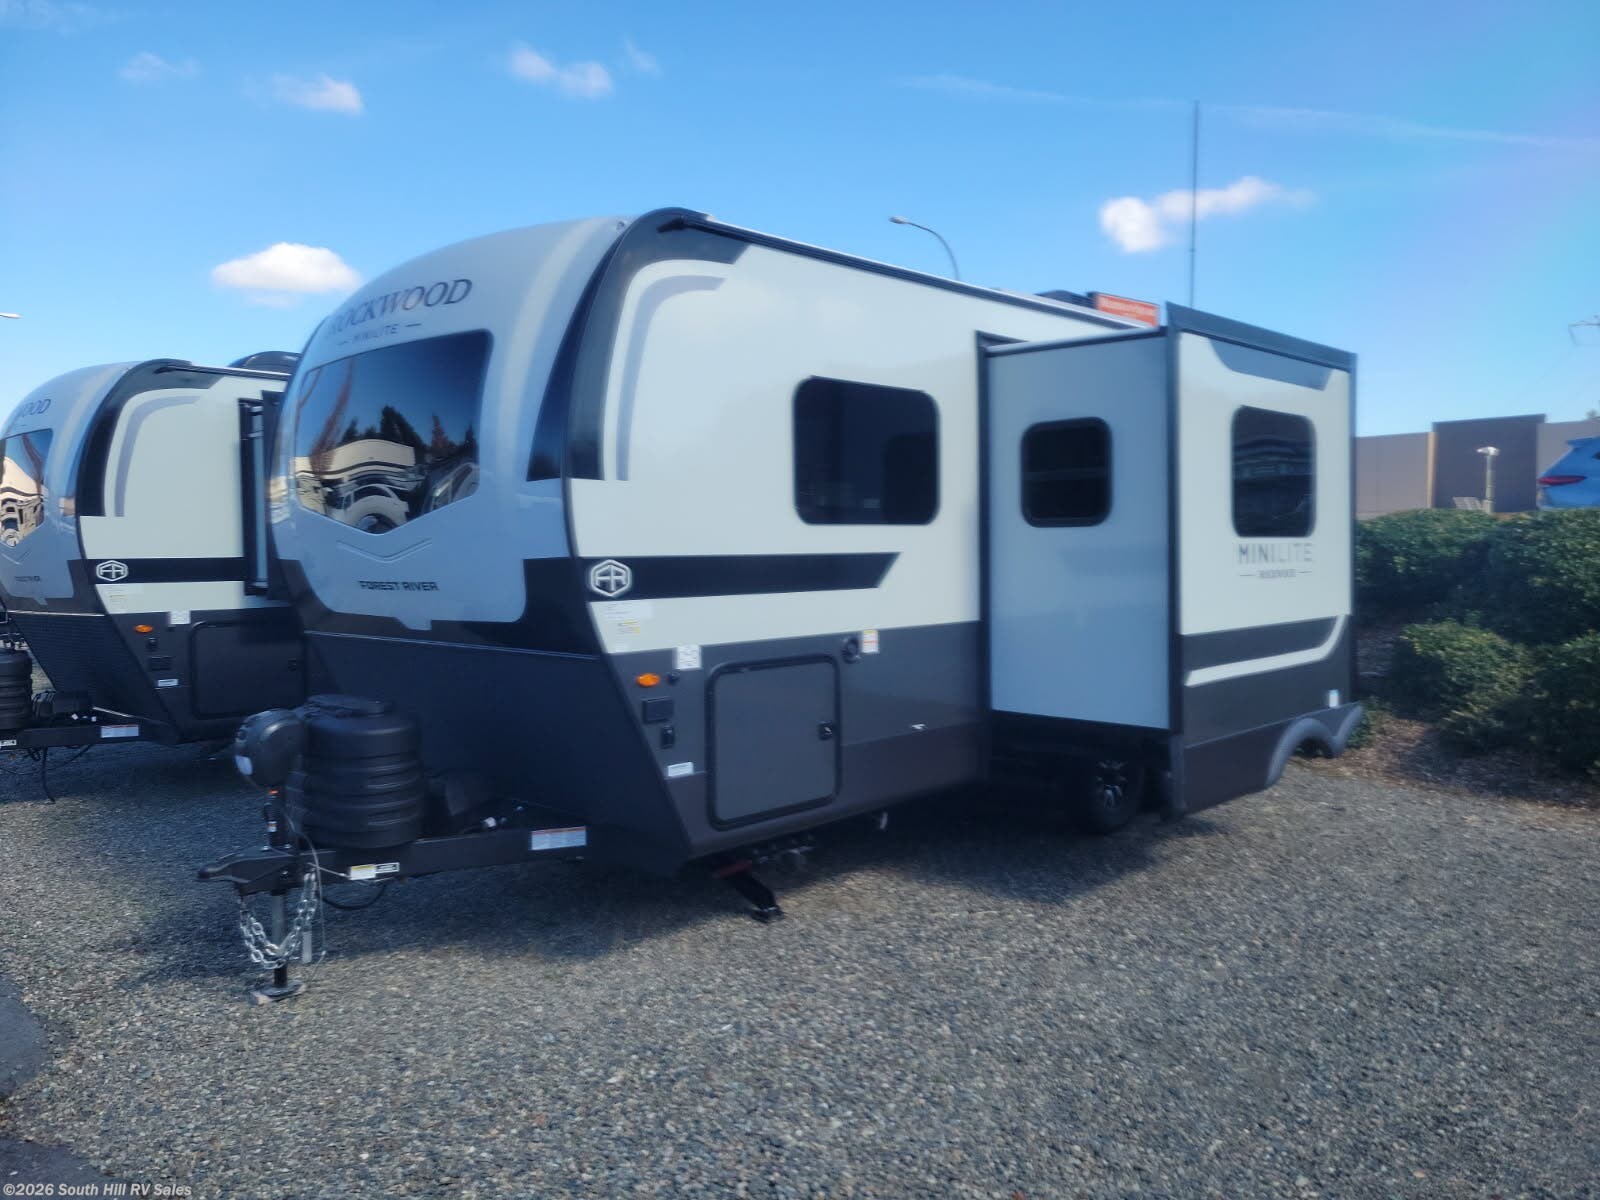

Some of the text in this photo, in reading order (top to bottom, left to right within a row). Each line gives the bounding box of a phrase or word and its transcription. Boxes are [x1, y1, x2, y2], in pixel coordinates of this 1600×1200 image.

[1238, 543, 1312, 563] MINILITE
[358, 580, 438, 592] FOREST RIVER
